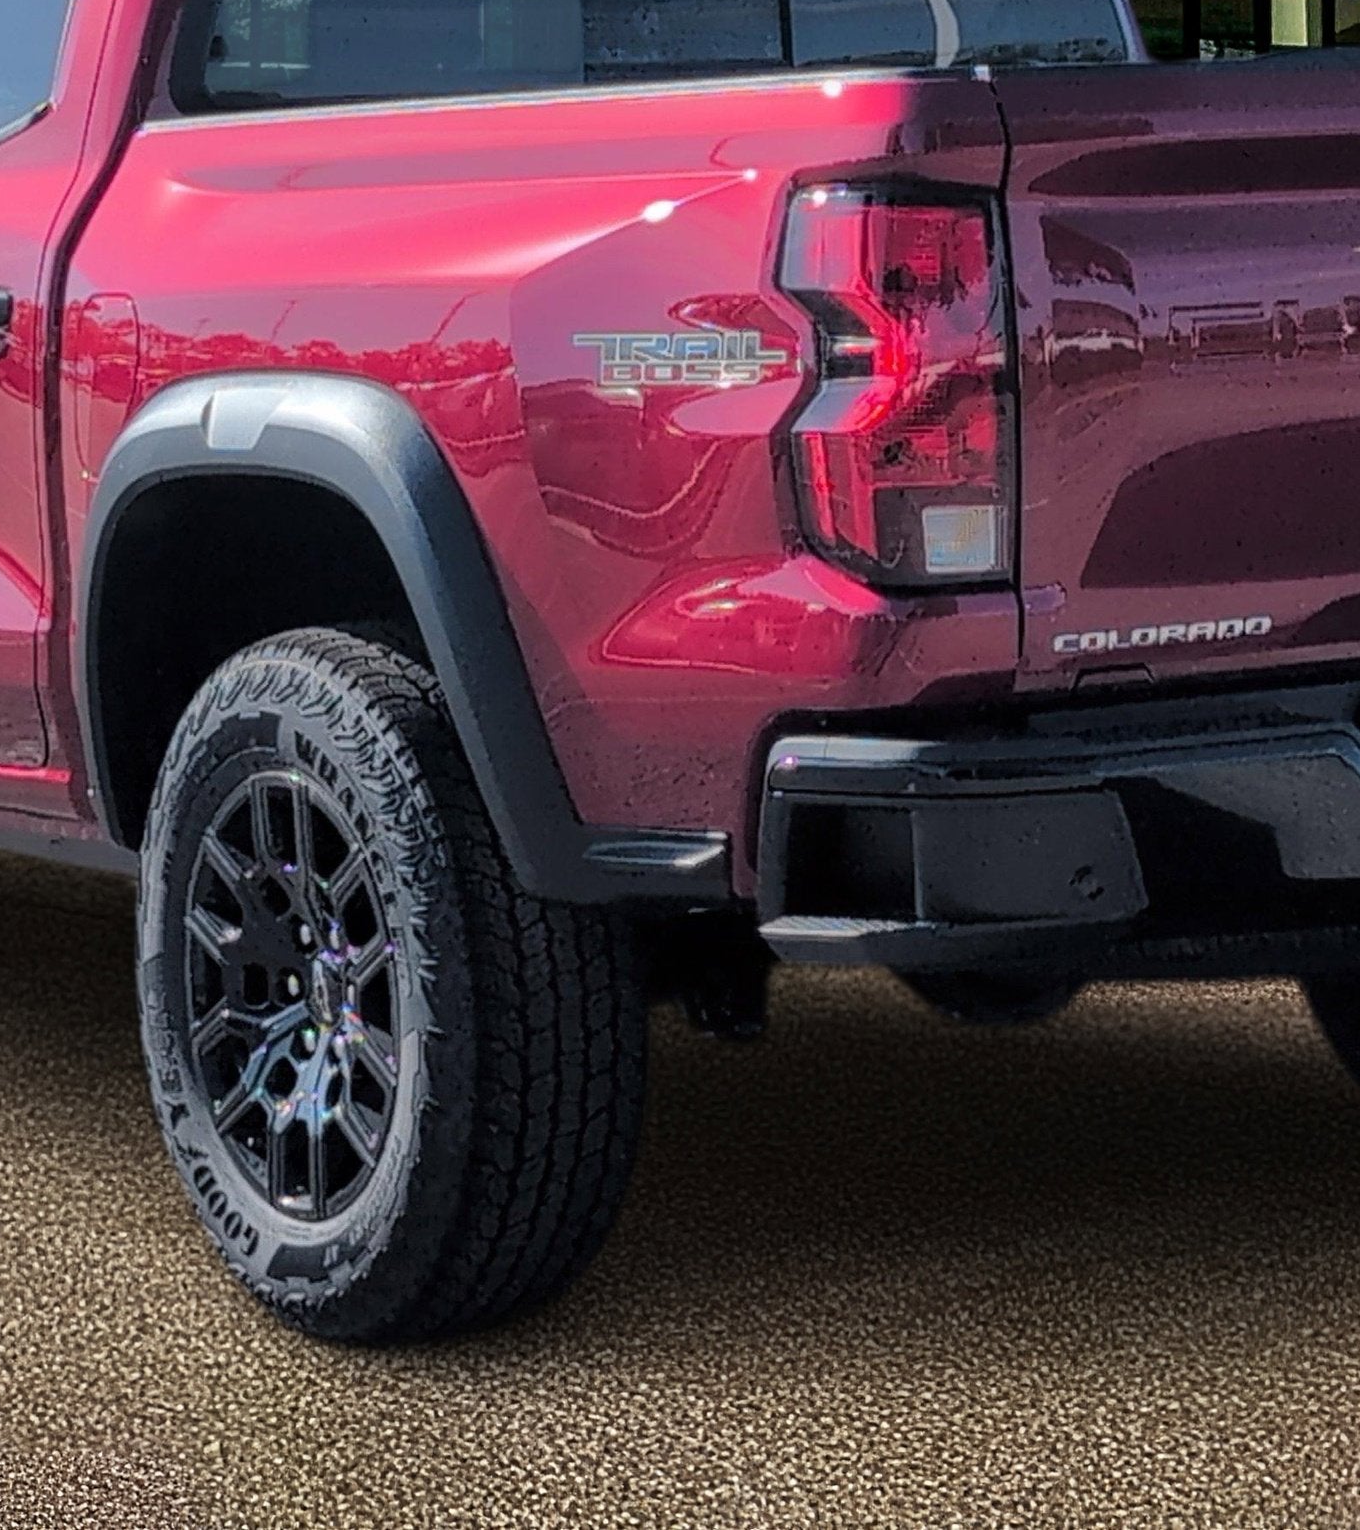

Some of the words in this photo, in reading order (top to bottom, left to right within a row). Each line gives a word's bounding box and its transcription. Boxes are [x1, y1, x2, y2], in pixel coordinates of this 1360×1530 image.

[573, 330, 788, 364] TRAIL
[600, 359, 761, 386] BOSS
[1052, 615, 1274, 654] COLORADO
